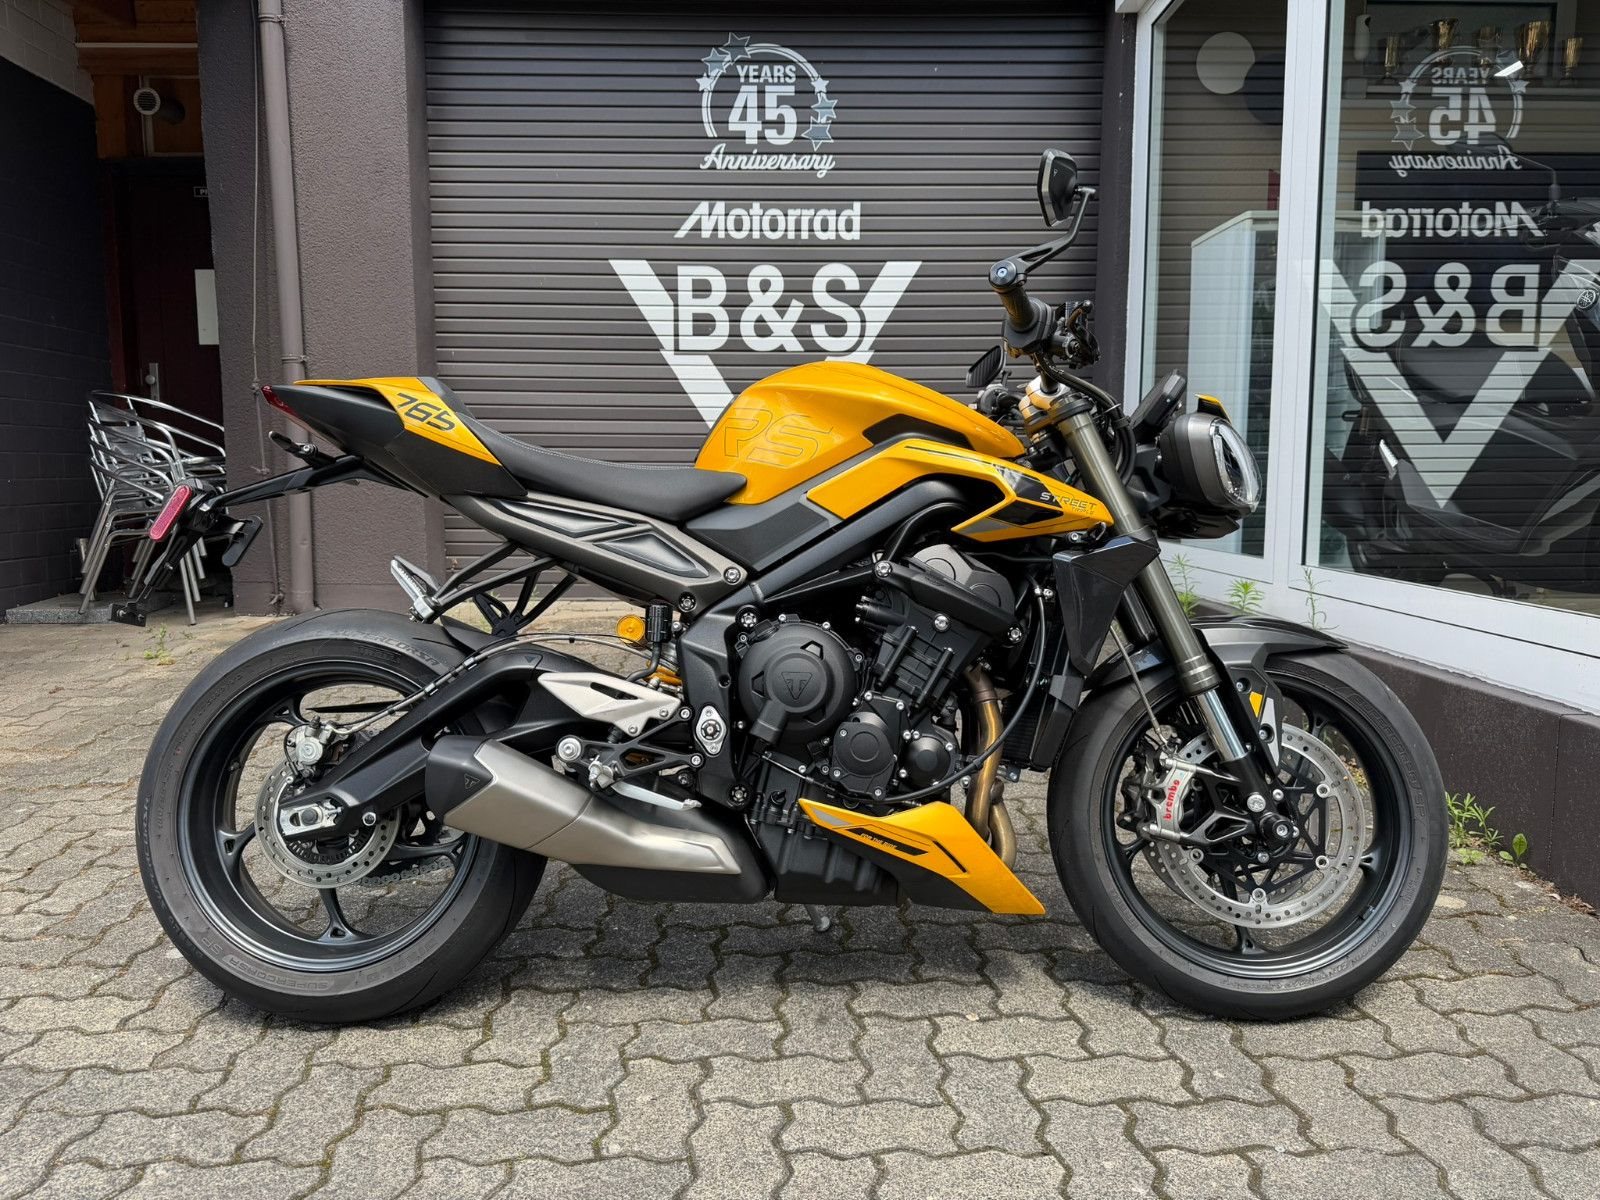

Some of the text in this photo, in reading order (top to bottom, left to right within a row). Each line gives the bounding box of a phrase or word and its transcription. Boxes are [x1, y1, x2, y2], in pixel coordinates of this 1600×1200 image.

[736, 65, 797, 84] YEARS
[728, 85, 798, 146] 45
[700, 143, 836, 178] Anniversary
[674, 202, 862, 241] Motorrad
[677, 262, 863, 352] B&S
[397, 392, 456, 432] 765
[1040, 492, 1098, 508] STREET
[1163, 779, 1181, 821] brembo
